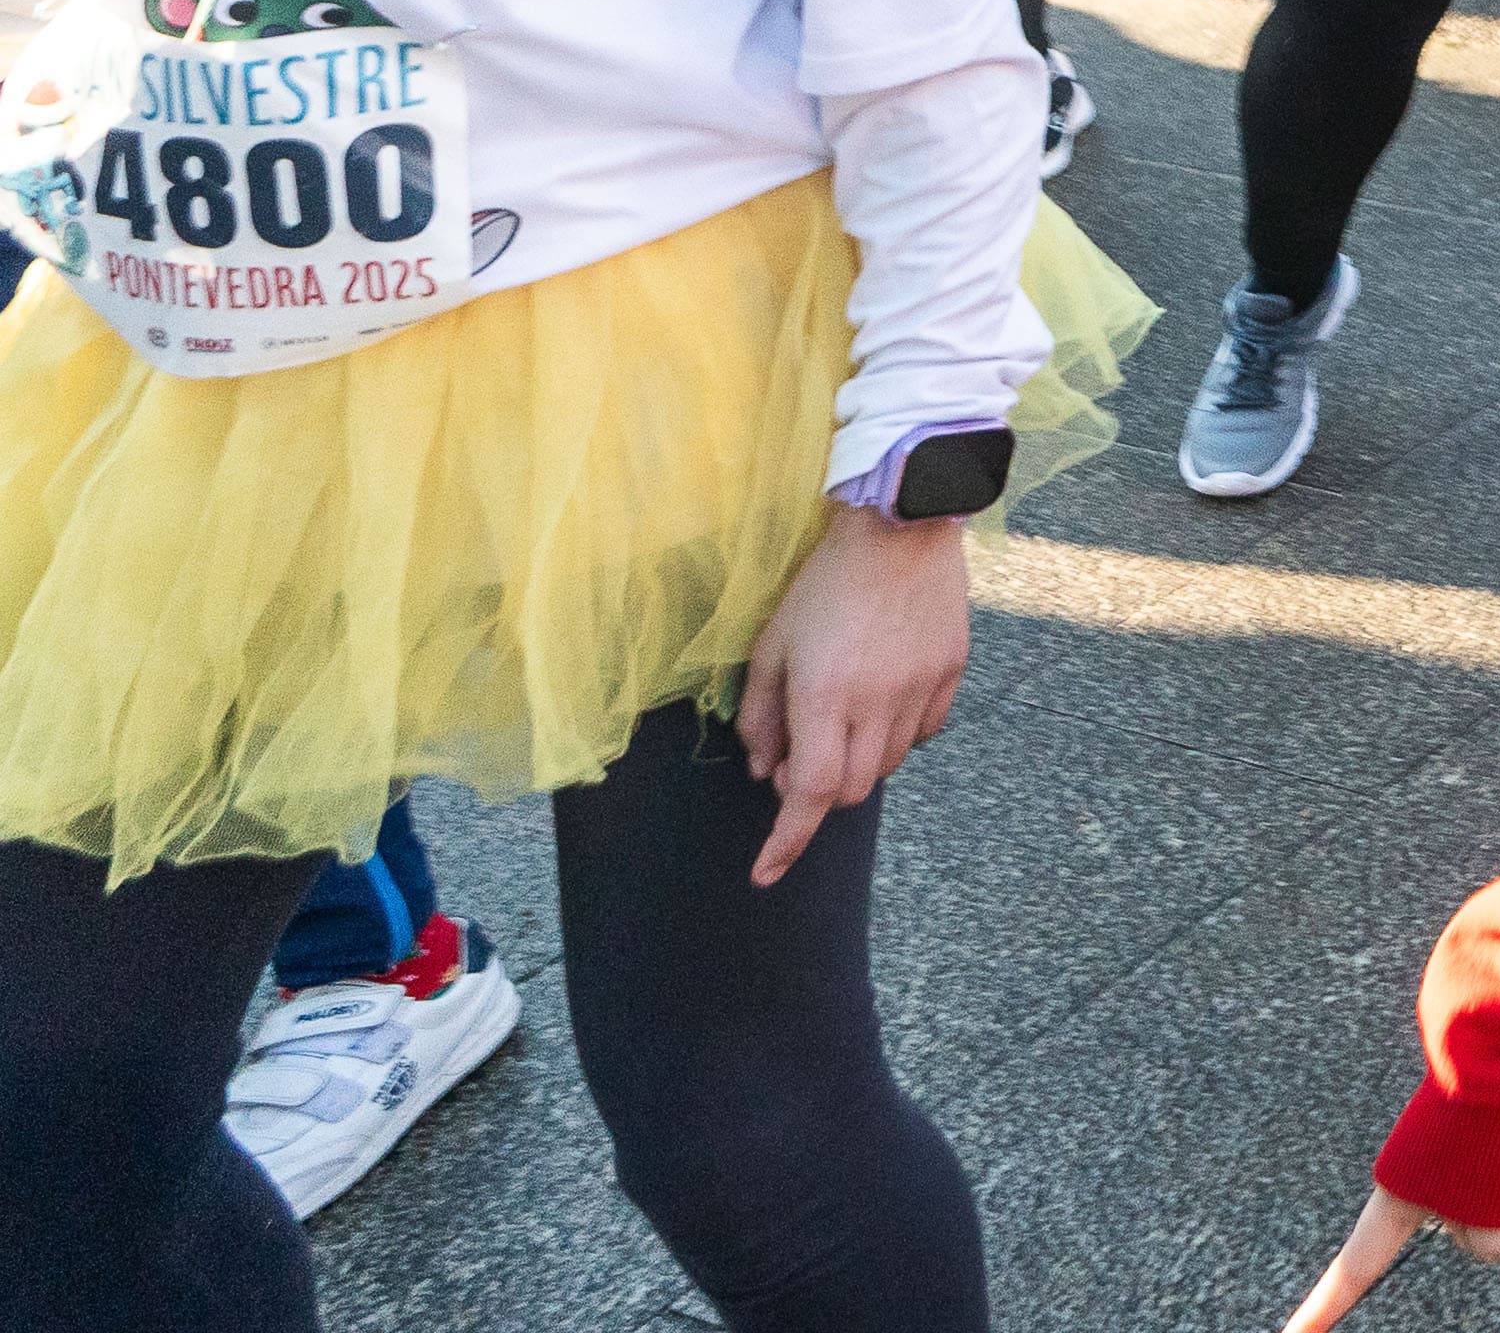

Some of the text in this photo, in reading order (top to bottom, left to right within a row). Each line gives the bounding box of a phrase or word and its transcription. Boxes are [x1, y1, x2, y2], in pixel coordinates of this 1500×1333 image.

[141, 42, 428, 127] SILVESTRE
[95, 122, 437, 249] 4800
[105, 249, 438, 310] PONTEVEDRA 2025
